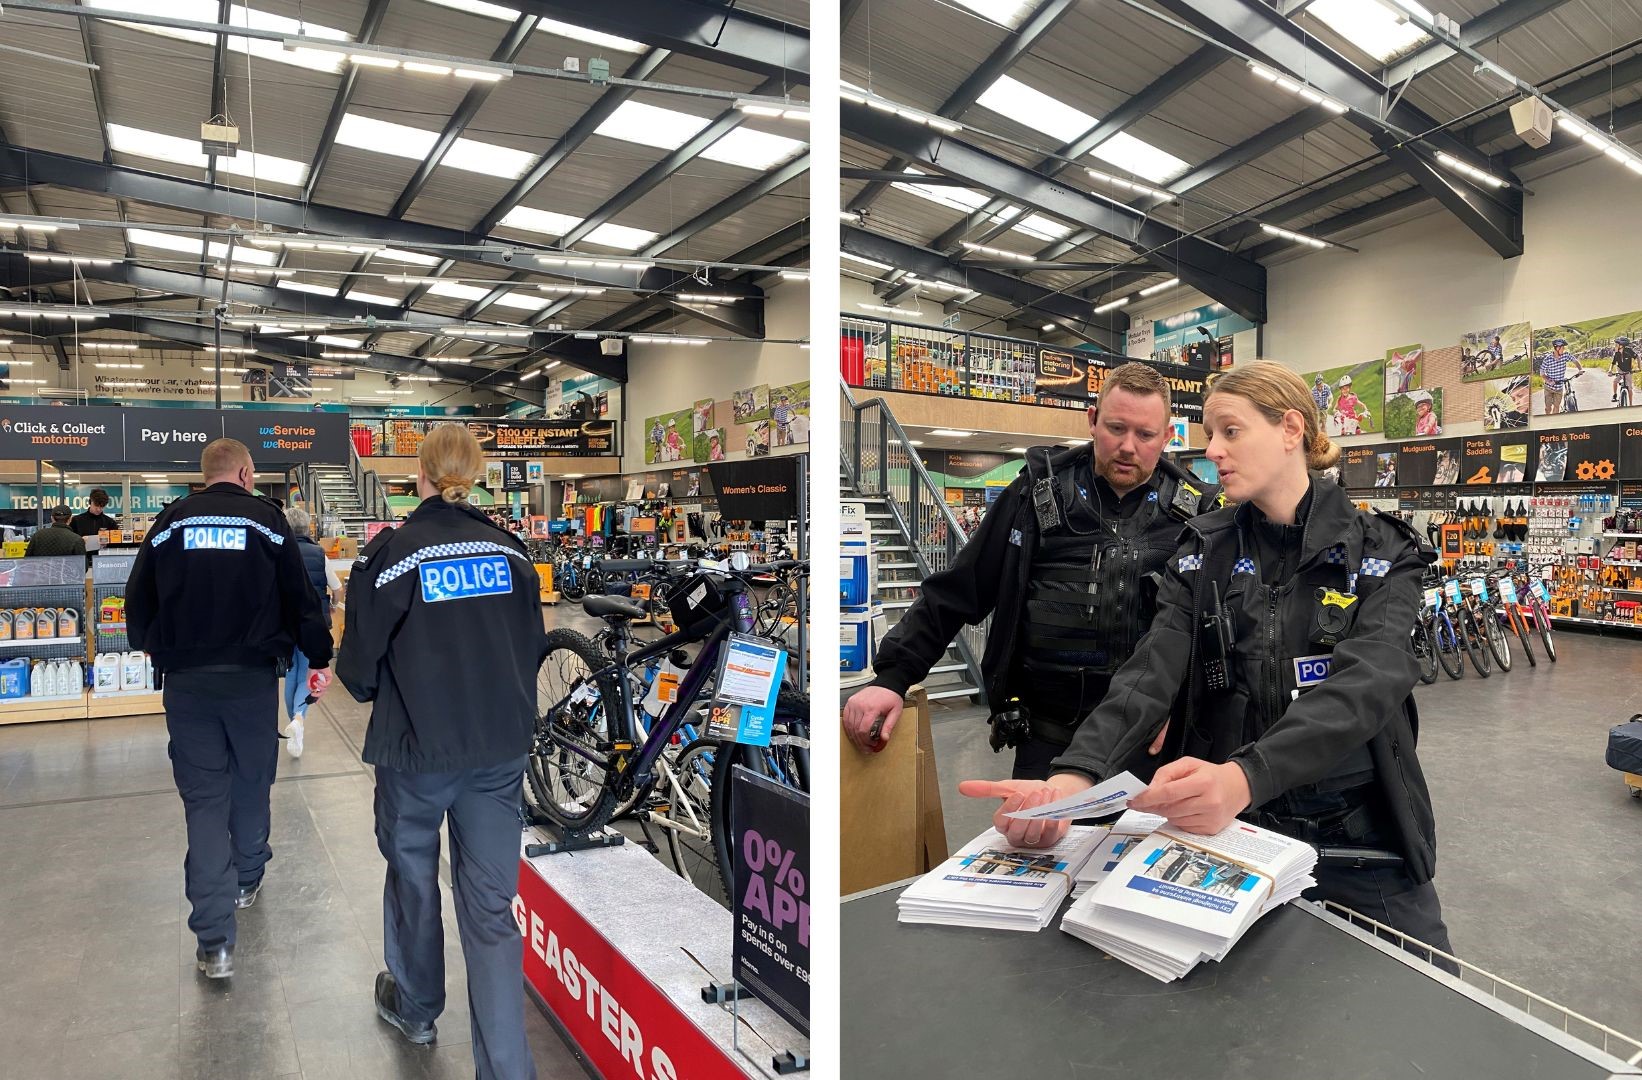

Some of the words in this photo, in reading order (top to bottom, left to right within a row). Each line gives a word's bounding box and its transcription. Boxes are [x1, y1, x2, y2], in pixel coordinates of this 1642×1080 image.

[1043, 360, 1071, 370] motoring
[140, 378, 160, 386] your
[94, 384, 110, 393] the
[137, 386, 161, 394] we're
[163, 386, 184, 394] here
[186, 387, 195, 395] to
[197, 386, 216, 397] help
[14, 422, 47, 433] Click
[50, 423, 60, 434] &
[62, 423, 106, 434] Collect
[259, 425, 316, 436] weService
[497, 428, 521, 437] £100
[522, 428, 536, 437] OF
[538, 428, 579, 437] INSTANT
[32, 434, 88, 446] motoring
[141, 428, 170, 445] Pay
[172, 430, 208, 442] here
[497, 436, 546, 445] BENEFITS
[1540, 434, 1560, 442] Parts
[1561, 433, 1568, 441] &
[1569, 432, 1590, 440] Tools
[262, 439, 313, 450] weRepair
[1402, 444, 1436, 454] Mudguards
[1466, 440, 1484, 448] Parts
[1348, 450, 1361, 458] Child
[1466, 447, 1493, 456] Saddles
[948, 460, 983, 468] Accessories
[722, 485, 756, 495] Women's
[758, 484, 787, 493] Classic
[184, 528, 246, 549] POLICE
[424, 561, 509, 594] POLICE
[710, 716, 730, 724] APR
[744, 829, 805, 897] 0%
[1159, 889, 1192, 903] elektryczne
[1184, 889, 1207, 900] Wielkiej
[1213, 897, 1236, 907] legalne
[1220, 904, 1232, 912] Czy
[742, 914, 758, 934] Pay
[759, 924, 767, 940] in
[768, 932, 775, 944] 6
[776, 940, 788, 954] on
[741, 928, 772, 957] spends
[774, 952, 794, 972] over
[531, 909, 645, 1080] EASTER
